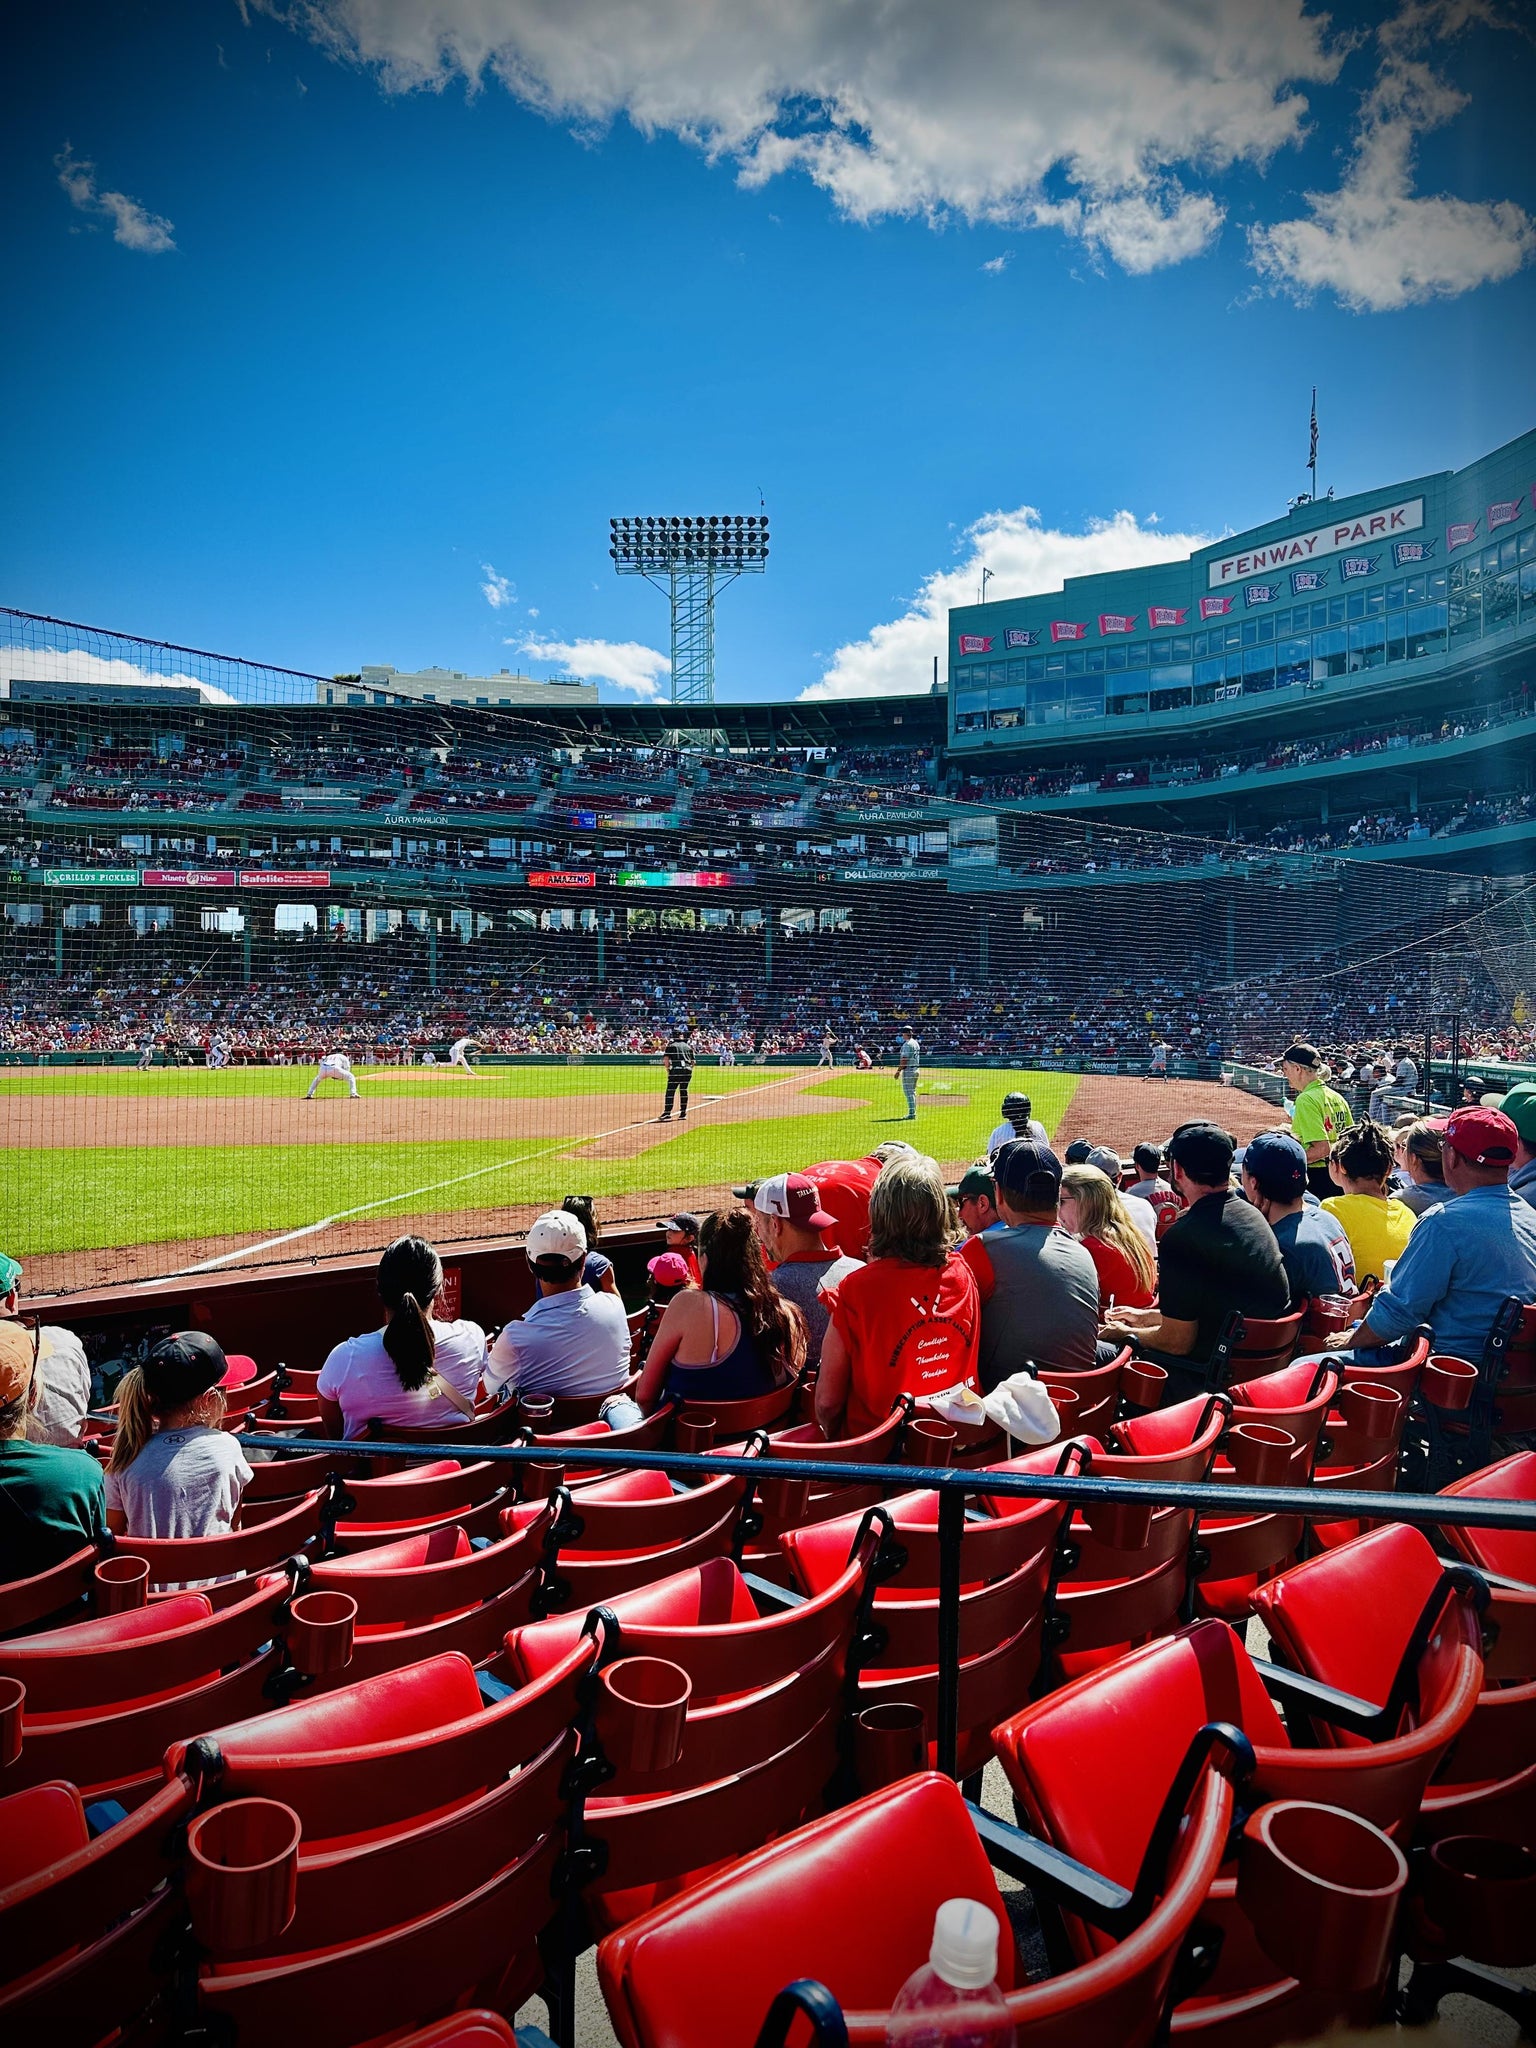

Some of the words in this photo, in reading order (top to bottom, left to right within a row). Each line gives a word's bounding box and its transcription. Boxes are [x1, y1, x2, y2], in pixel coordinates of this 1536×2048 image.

[1221, 535, 1318, 579] FENWAY
[1334, 509, 1406, 545] PARK
[1345, 560, 1369, 572] 1975
[887, 810, 923, 819] PAVILION
[412, 816, 449, 824] PAVILION
[60, 873, 96, 881] GRILLO'S
[100, 873, 136, 881] PICKLES
[161, 874, 186, 882] Ninety
[241, 874, 284, 883] Safelite
[844, 871, 867, 879] DELL
[867, 869, 917, 879] Technologies
[918, 869, 939, 877] Level
[548, 875, 590, 884] AMAZING
[1092, 1061, 1119, 1070] National
[889, 1318, 926, 1368] SUBSCRIPTION
[1493, 1337, 1503, 1347] C
[1218, 1344, 1227, 1354] B
